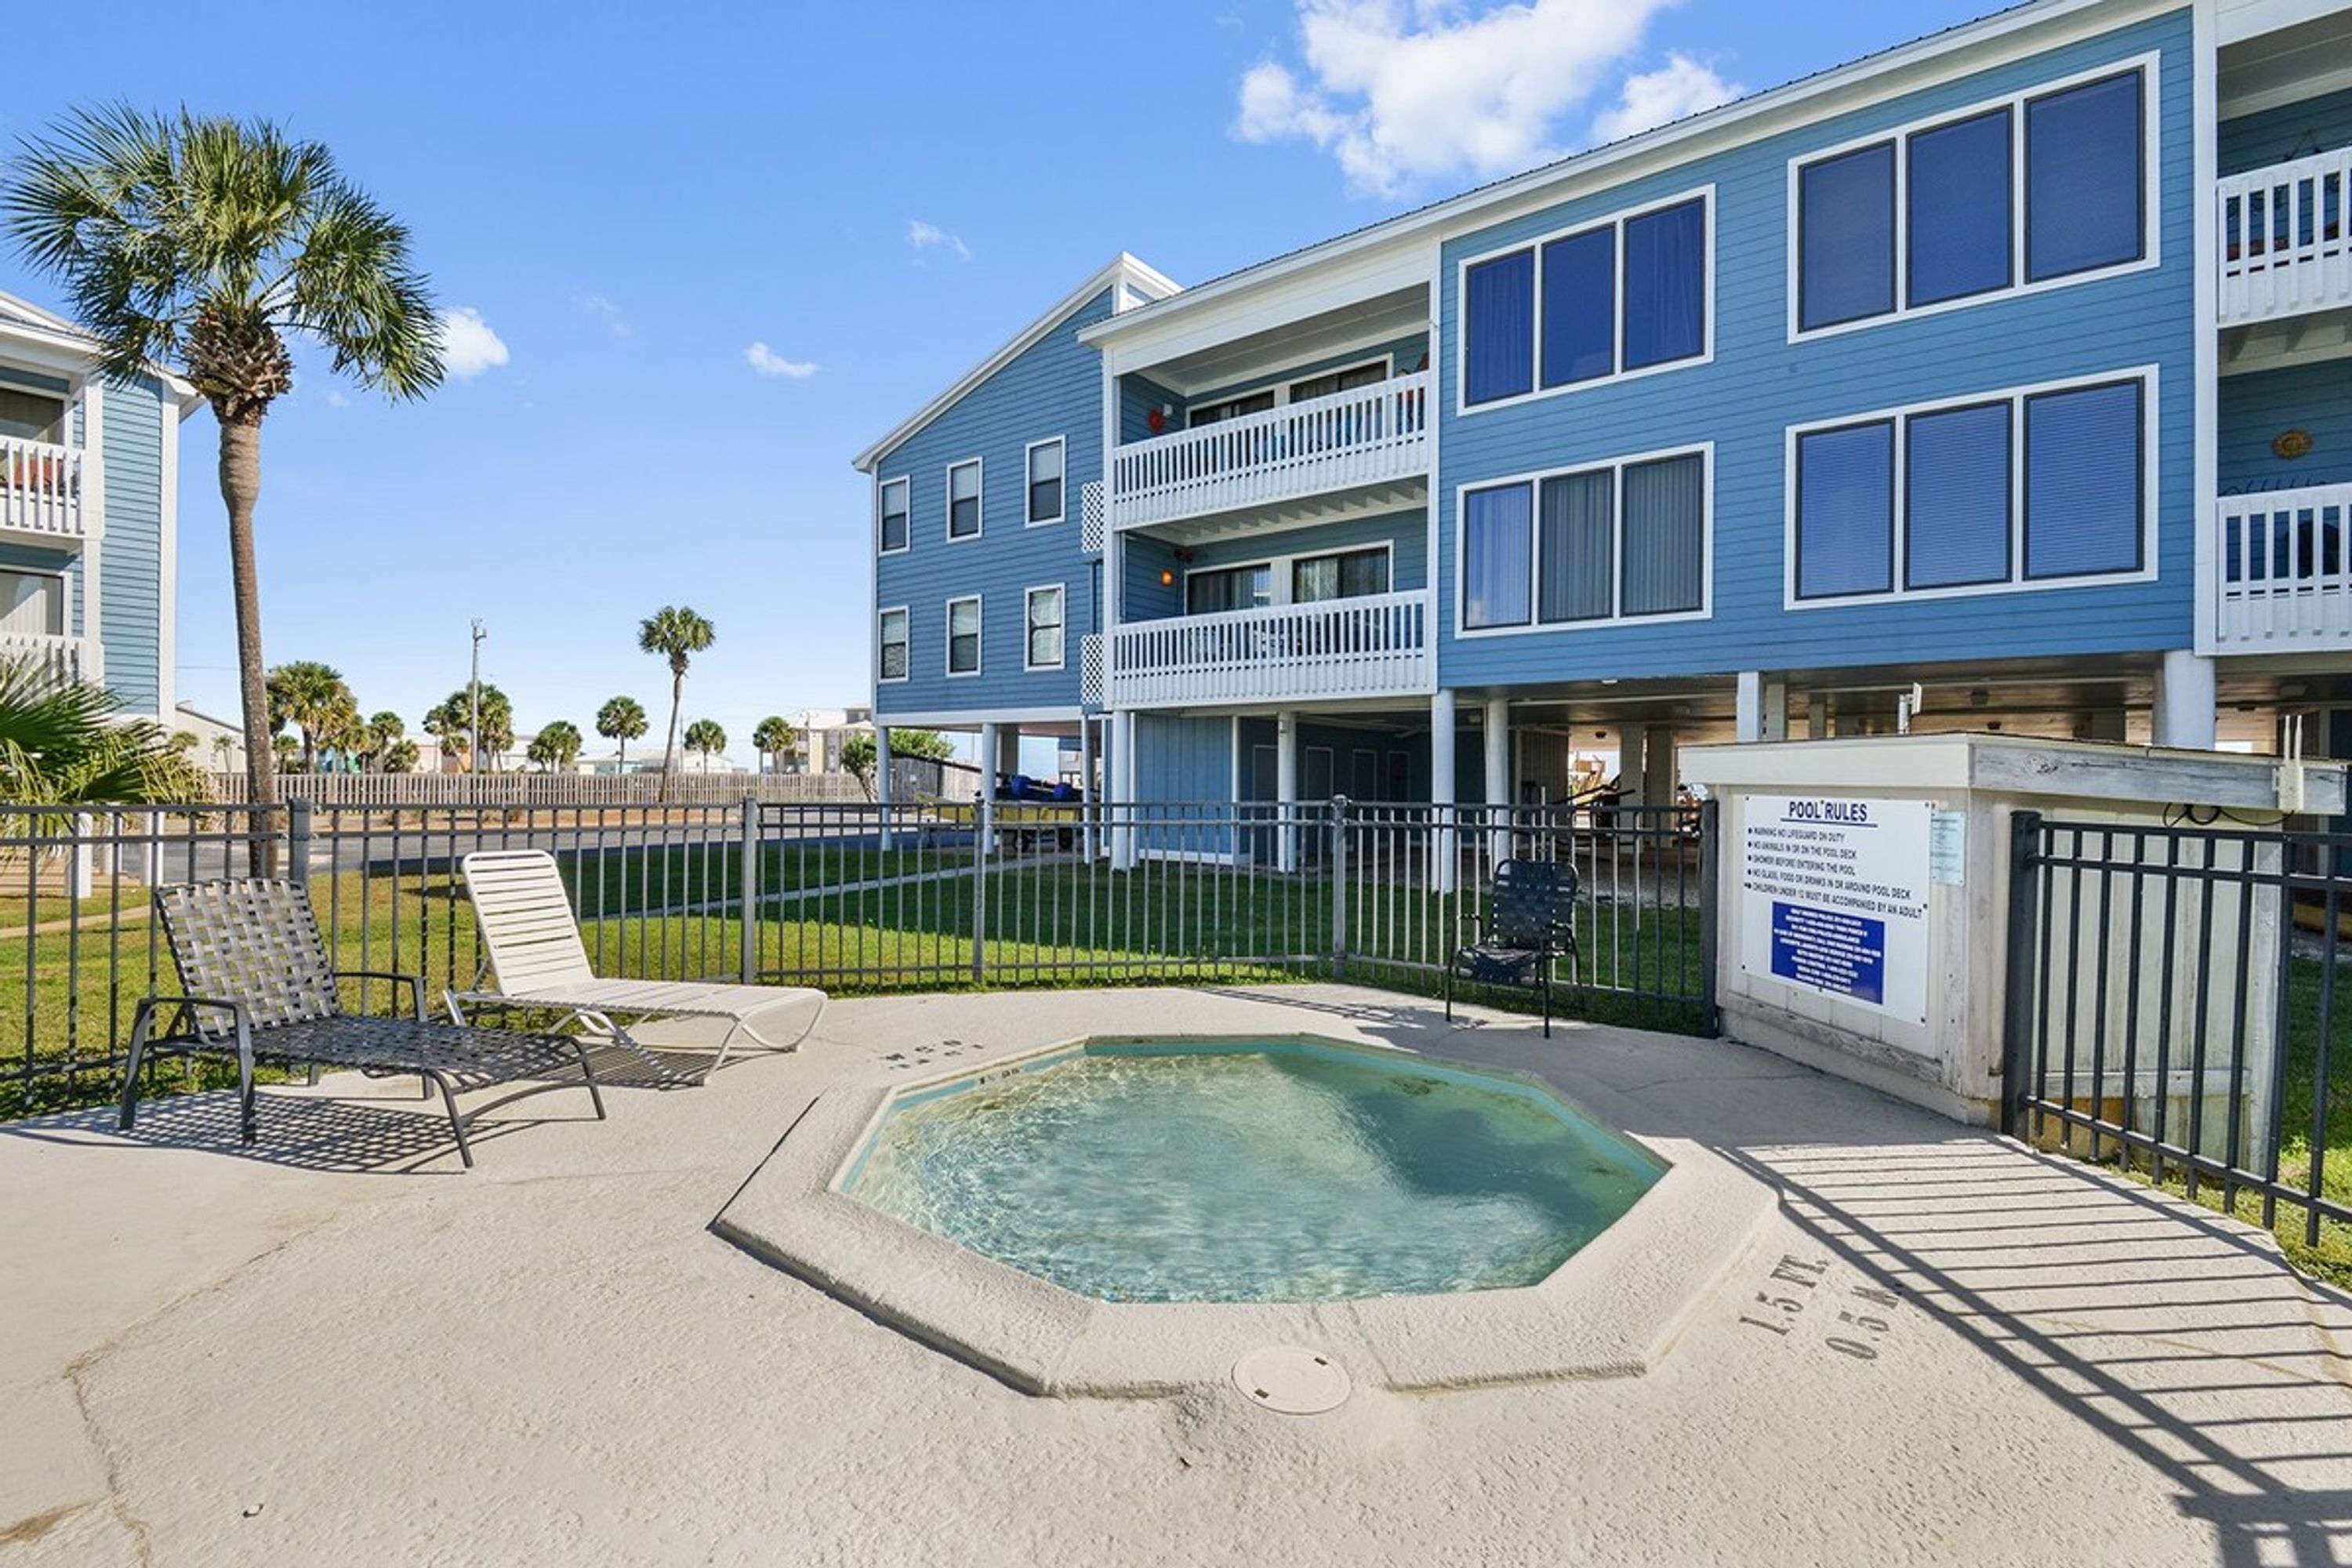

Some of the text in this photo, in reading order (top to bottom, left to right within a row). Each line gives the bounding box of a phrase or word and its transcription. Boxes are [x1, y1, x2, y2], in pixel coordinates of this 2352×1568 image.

[1789, 800, 1867, 822] POOL RULES
[1828, 832, 1845, 843] DUTY
[1823, 847, 1838, 858] POOL
[1840, 848, 1857, 859] DECK
[1827, 862, 1838, 873] THE
[1838, 864, 1856, 877] POOL
[1871, 884, 1890, 897] POOL
[1892, 887, 1911, 900] DECK
[1878, 902, 1886, 913] BY
[1887, 904, 1897, 914] AN
[1899, 905, 1922, 920] ADULT
[1738, 1290, 1805, 1336] 1.5
[1824, 1310, 1890, 1360] 0.5
